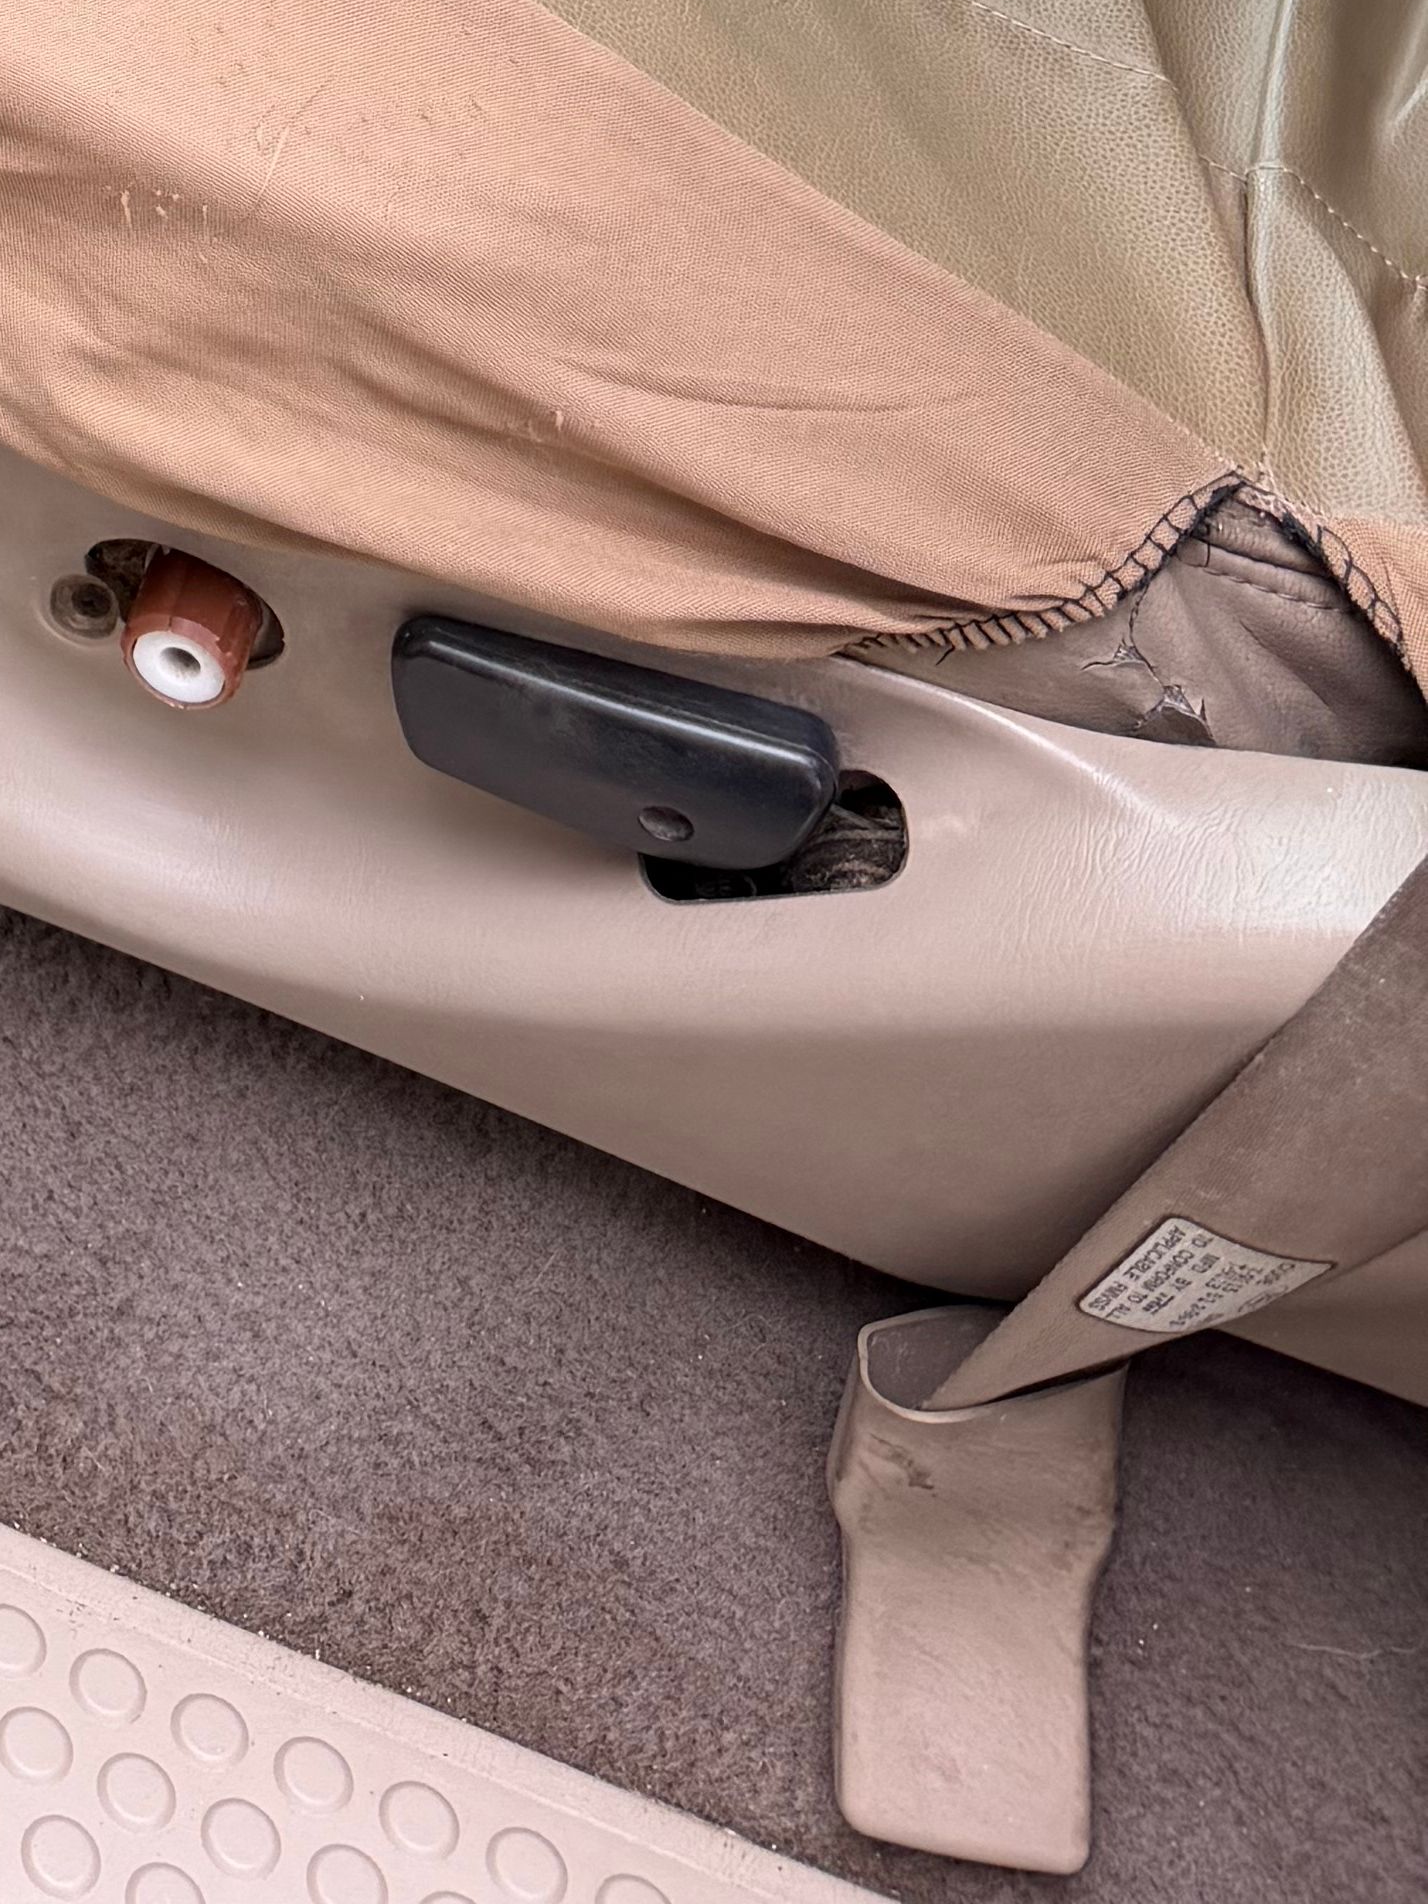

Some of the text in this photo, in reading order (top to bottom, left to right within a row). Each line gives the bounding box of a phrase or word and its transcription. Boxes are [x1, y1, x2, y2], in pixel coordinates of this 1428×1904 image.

[1122, 1225, 1187, 1281] APPLICABLE
[1142, 1249, 1194, 1293] CONFORM
[1129, 1290, 1149, 1304] TO
